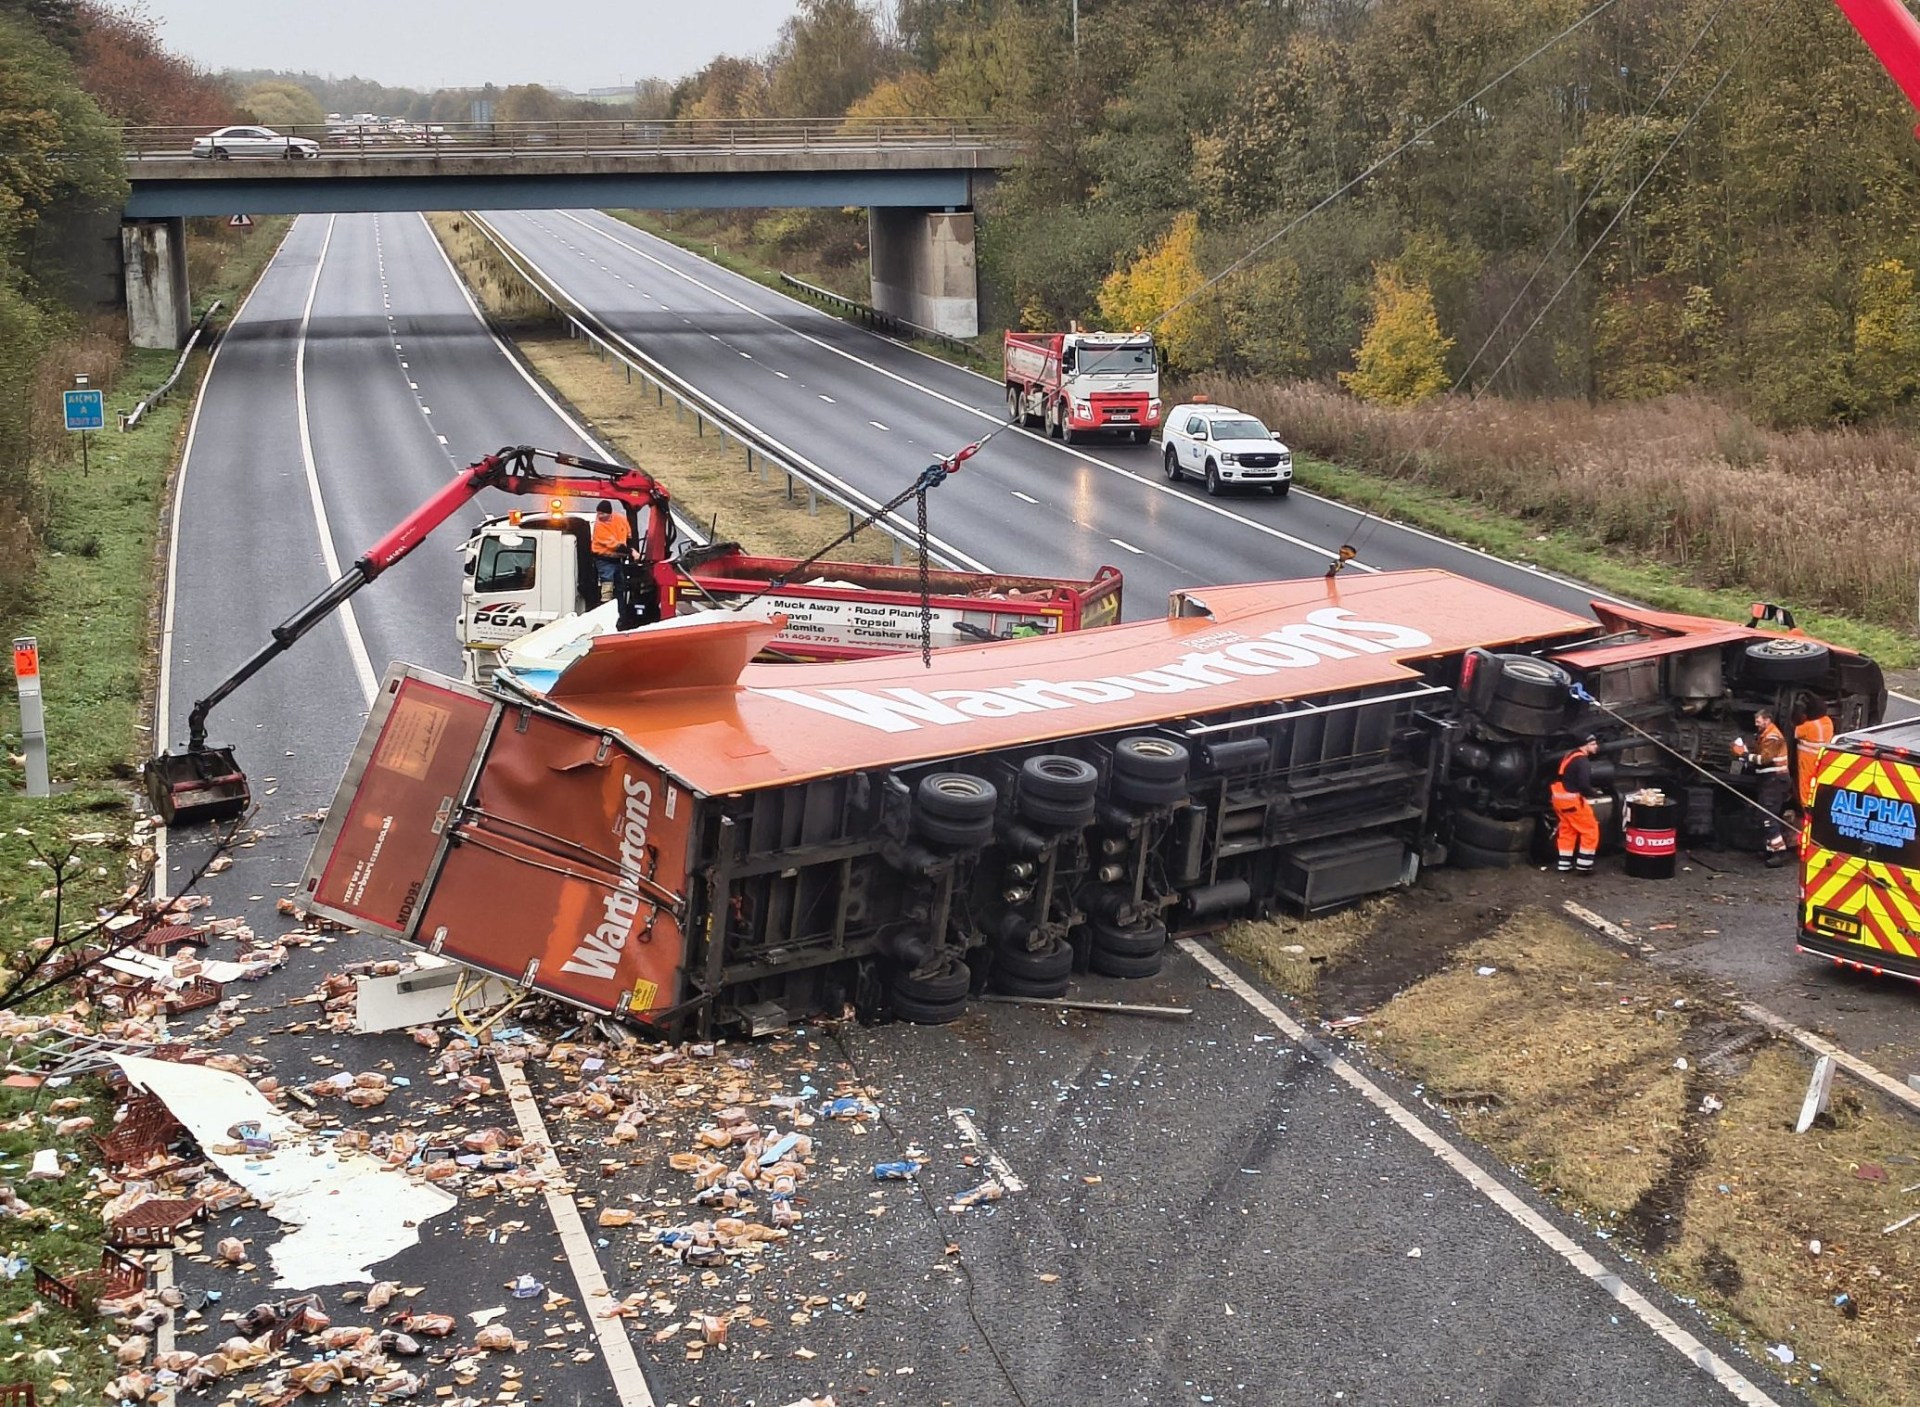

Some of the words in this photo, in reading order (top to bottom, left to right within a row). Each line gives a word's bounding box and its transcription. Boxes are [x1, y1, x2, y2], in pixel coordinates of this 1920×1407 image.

[774, 601, 805, 609] Muck
[809, 603, 840, 613] Away
[855, 606, 885, 615] Road
[474, 612, 527, 628] PGA
[774, 611, 812, 621] avel
[854, 617, 896, 628] Topsoil
[783, 623, 825, 633] lomite
[854, 629, 902, 639] Crusher
[906, 632, 927, 640] Hir
[744, 607, 1432, 733] Warburtons
[1831, 789, 1916, 828] ALPHA
[1831, 811, 1867, 830] TRUCK
[1868, 820, 1916, 840] RESCUE
[1647, 837, 1675, 846] TEXACO
[343, 881, 355, 903] VISIT
[351, 870, 360, 882] US
[356, 860, 364, 871] AT
[560, 773, 651, 980] Warburtons
[396, 881, 421, 925] MDD95
